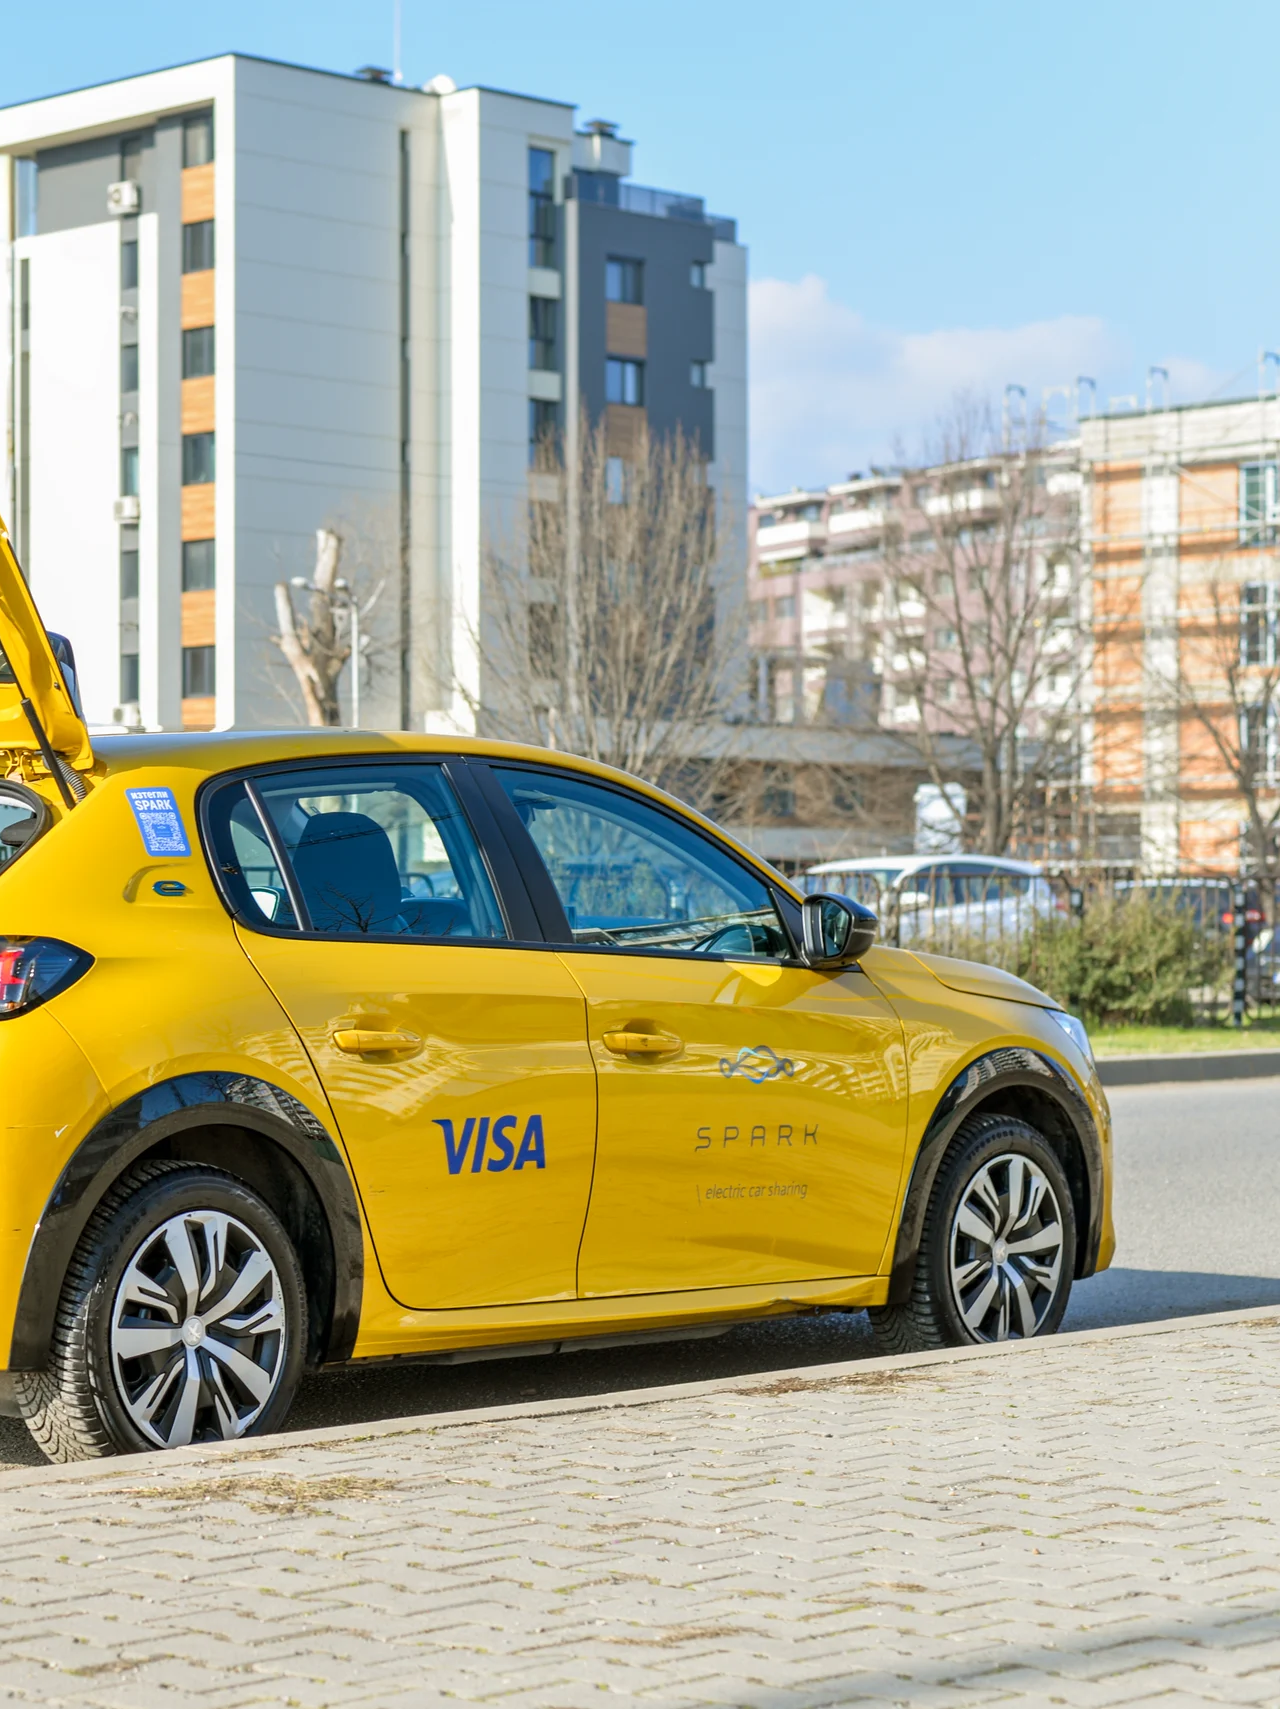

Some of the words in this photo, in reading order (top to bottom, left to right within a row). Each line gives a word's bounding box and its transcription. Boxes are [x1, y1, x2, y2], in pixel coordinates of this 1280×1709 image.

[134, 799, 174, 811] SPARK
[431, 1114, 546, 1175] VISA
[694, 1123, 819, 1153] SPARK
[705, 1184, 746, 1200] electric
[748, 1185, 766, 1198] car
[767, 1181, 808, 1200] sharing
